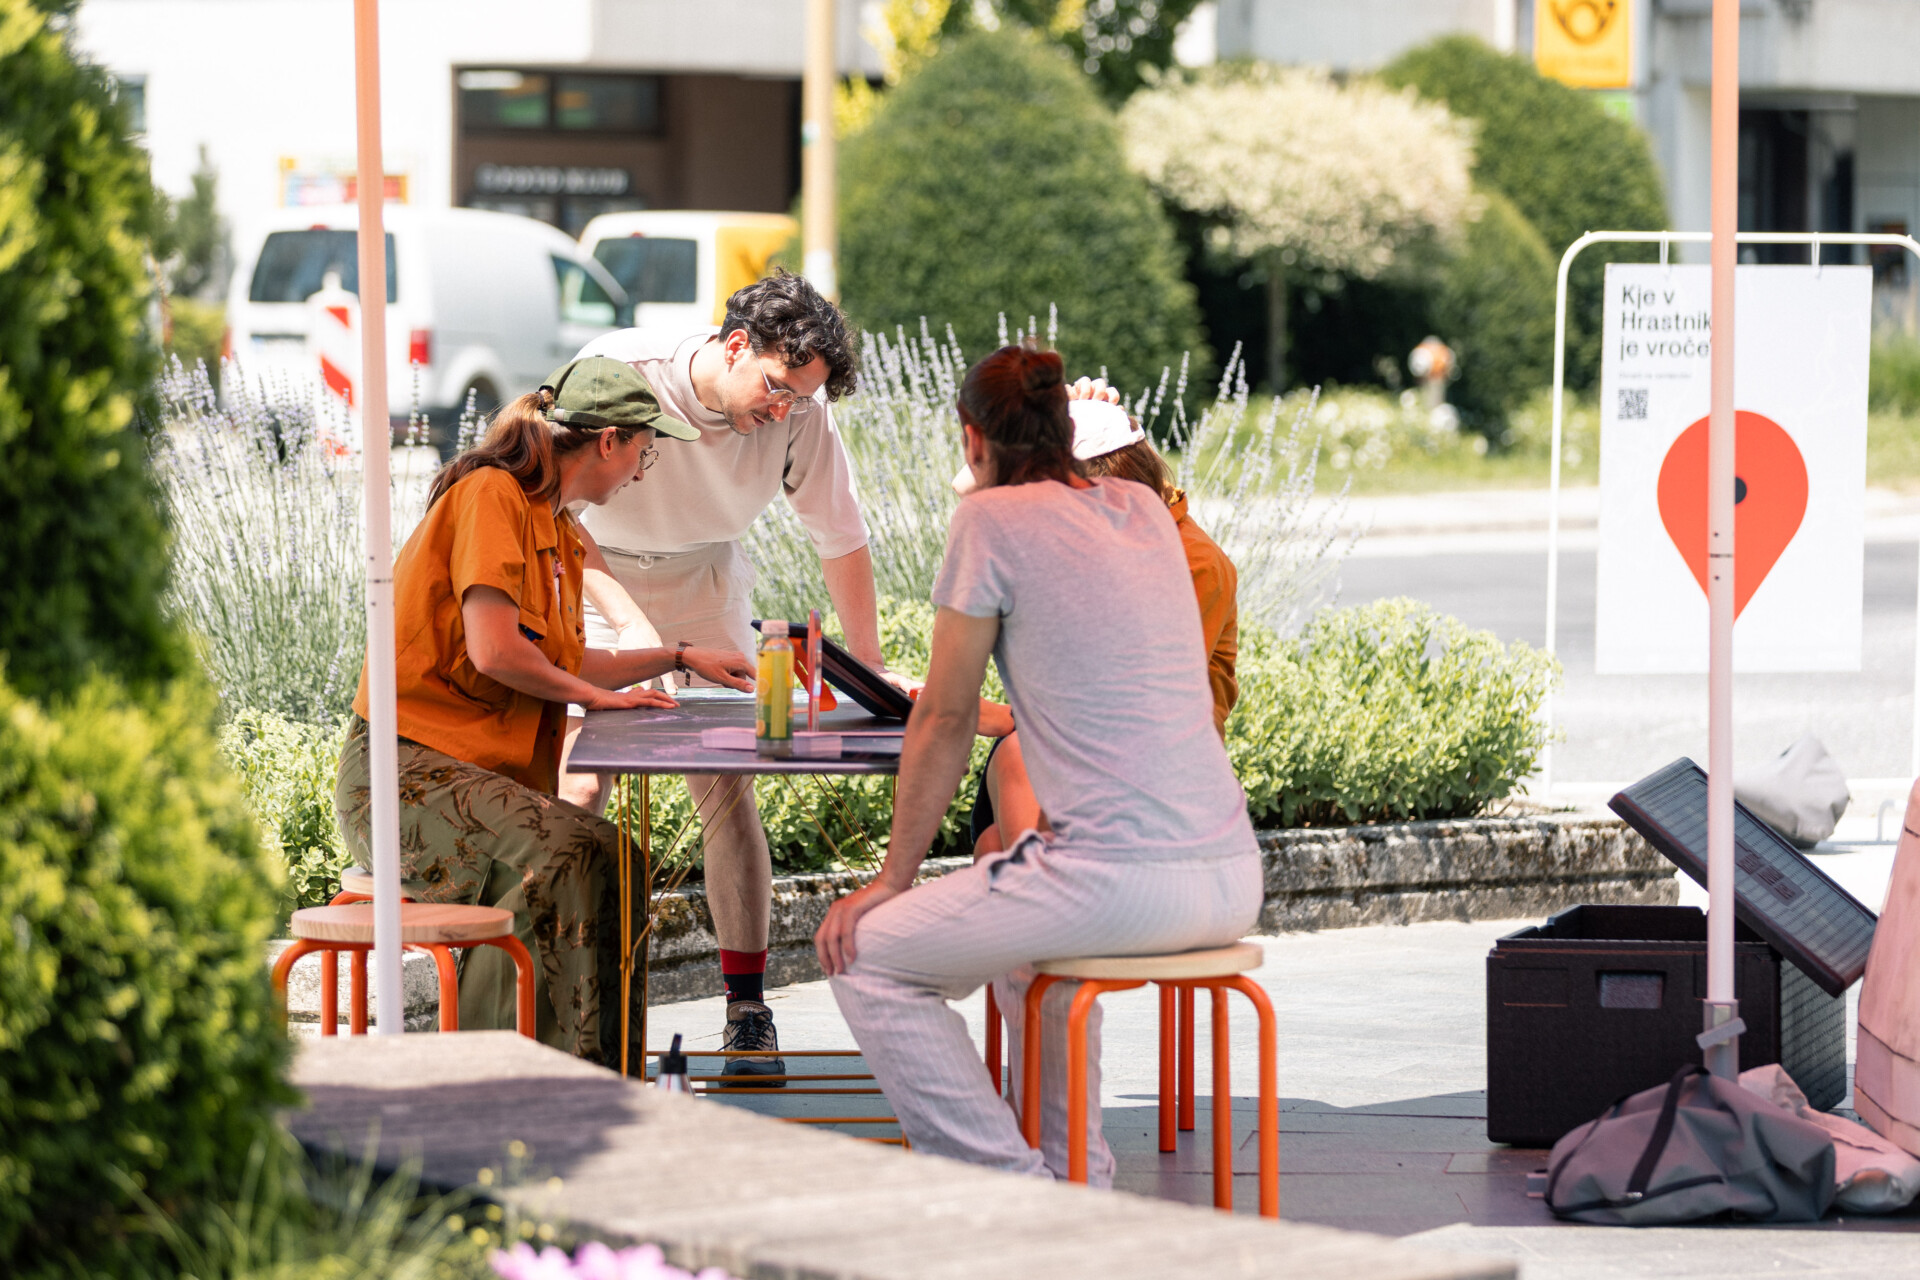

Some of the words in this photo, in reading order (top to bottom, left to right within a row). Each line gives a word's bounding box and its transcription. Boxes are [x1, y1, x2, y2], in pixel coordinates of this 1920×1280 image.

[1622, 284, 1655, 310] Kje
[1663, 289, 1675, 305] v
[1621, 310, 1712, 331] Hrastnik
[1620, 335, 1639, 361] je
[1646, 335, 1712, 357] vroče
